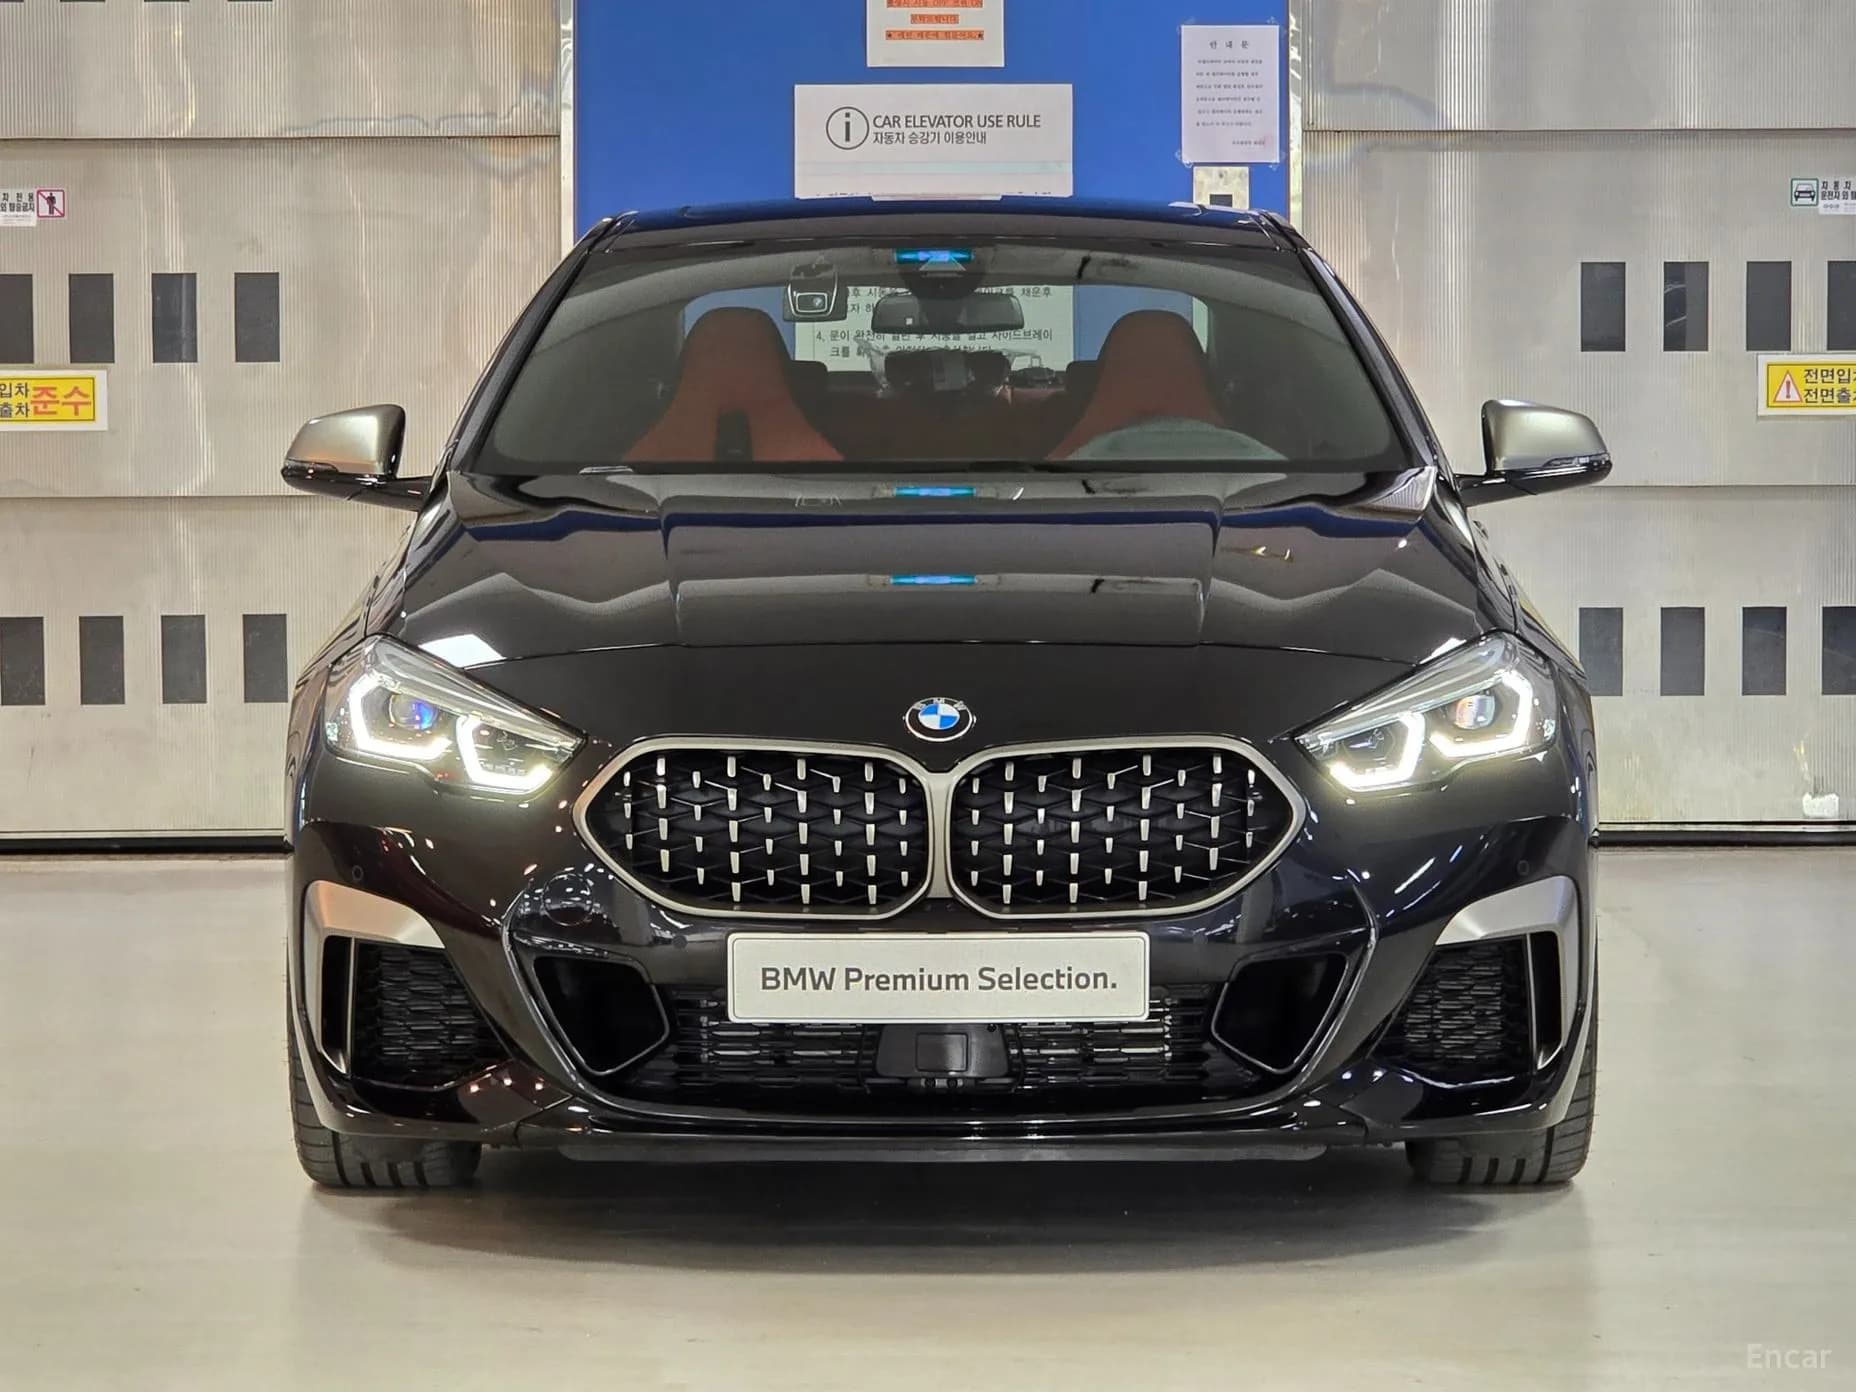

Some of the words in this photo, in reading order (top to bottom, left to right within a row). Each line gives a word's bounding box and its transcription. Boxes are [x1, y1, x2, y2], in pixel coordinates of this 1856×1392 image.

[872, 114, 902, 129] CAR
[904, 114, 974, 129] ELEVATOR
[977, 114, 1004, 129] USE
[1006, 114, 1042, 129] RULE
[872, 131, 906, 145] 자동차
[908, 131, 941, 145] 승강기
[943, 131, 987, 145] 이용안내
[1803, 367, 1856, 385] 전면입
[30, 385, 92, 417] 준수
[1803, 387, 1856, 404] 전면출
[760, 966, 836, 991] BMW
[844, 966, 969, 991] Premium
[977, 965, 1118, 991] Selection.
